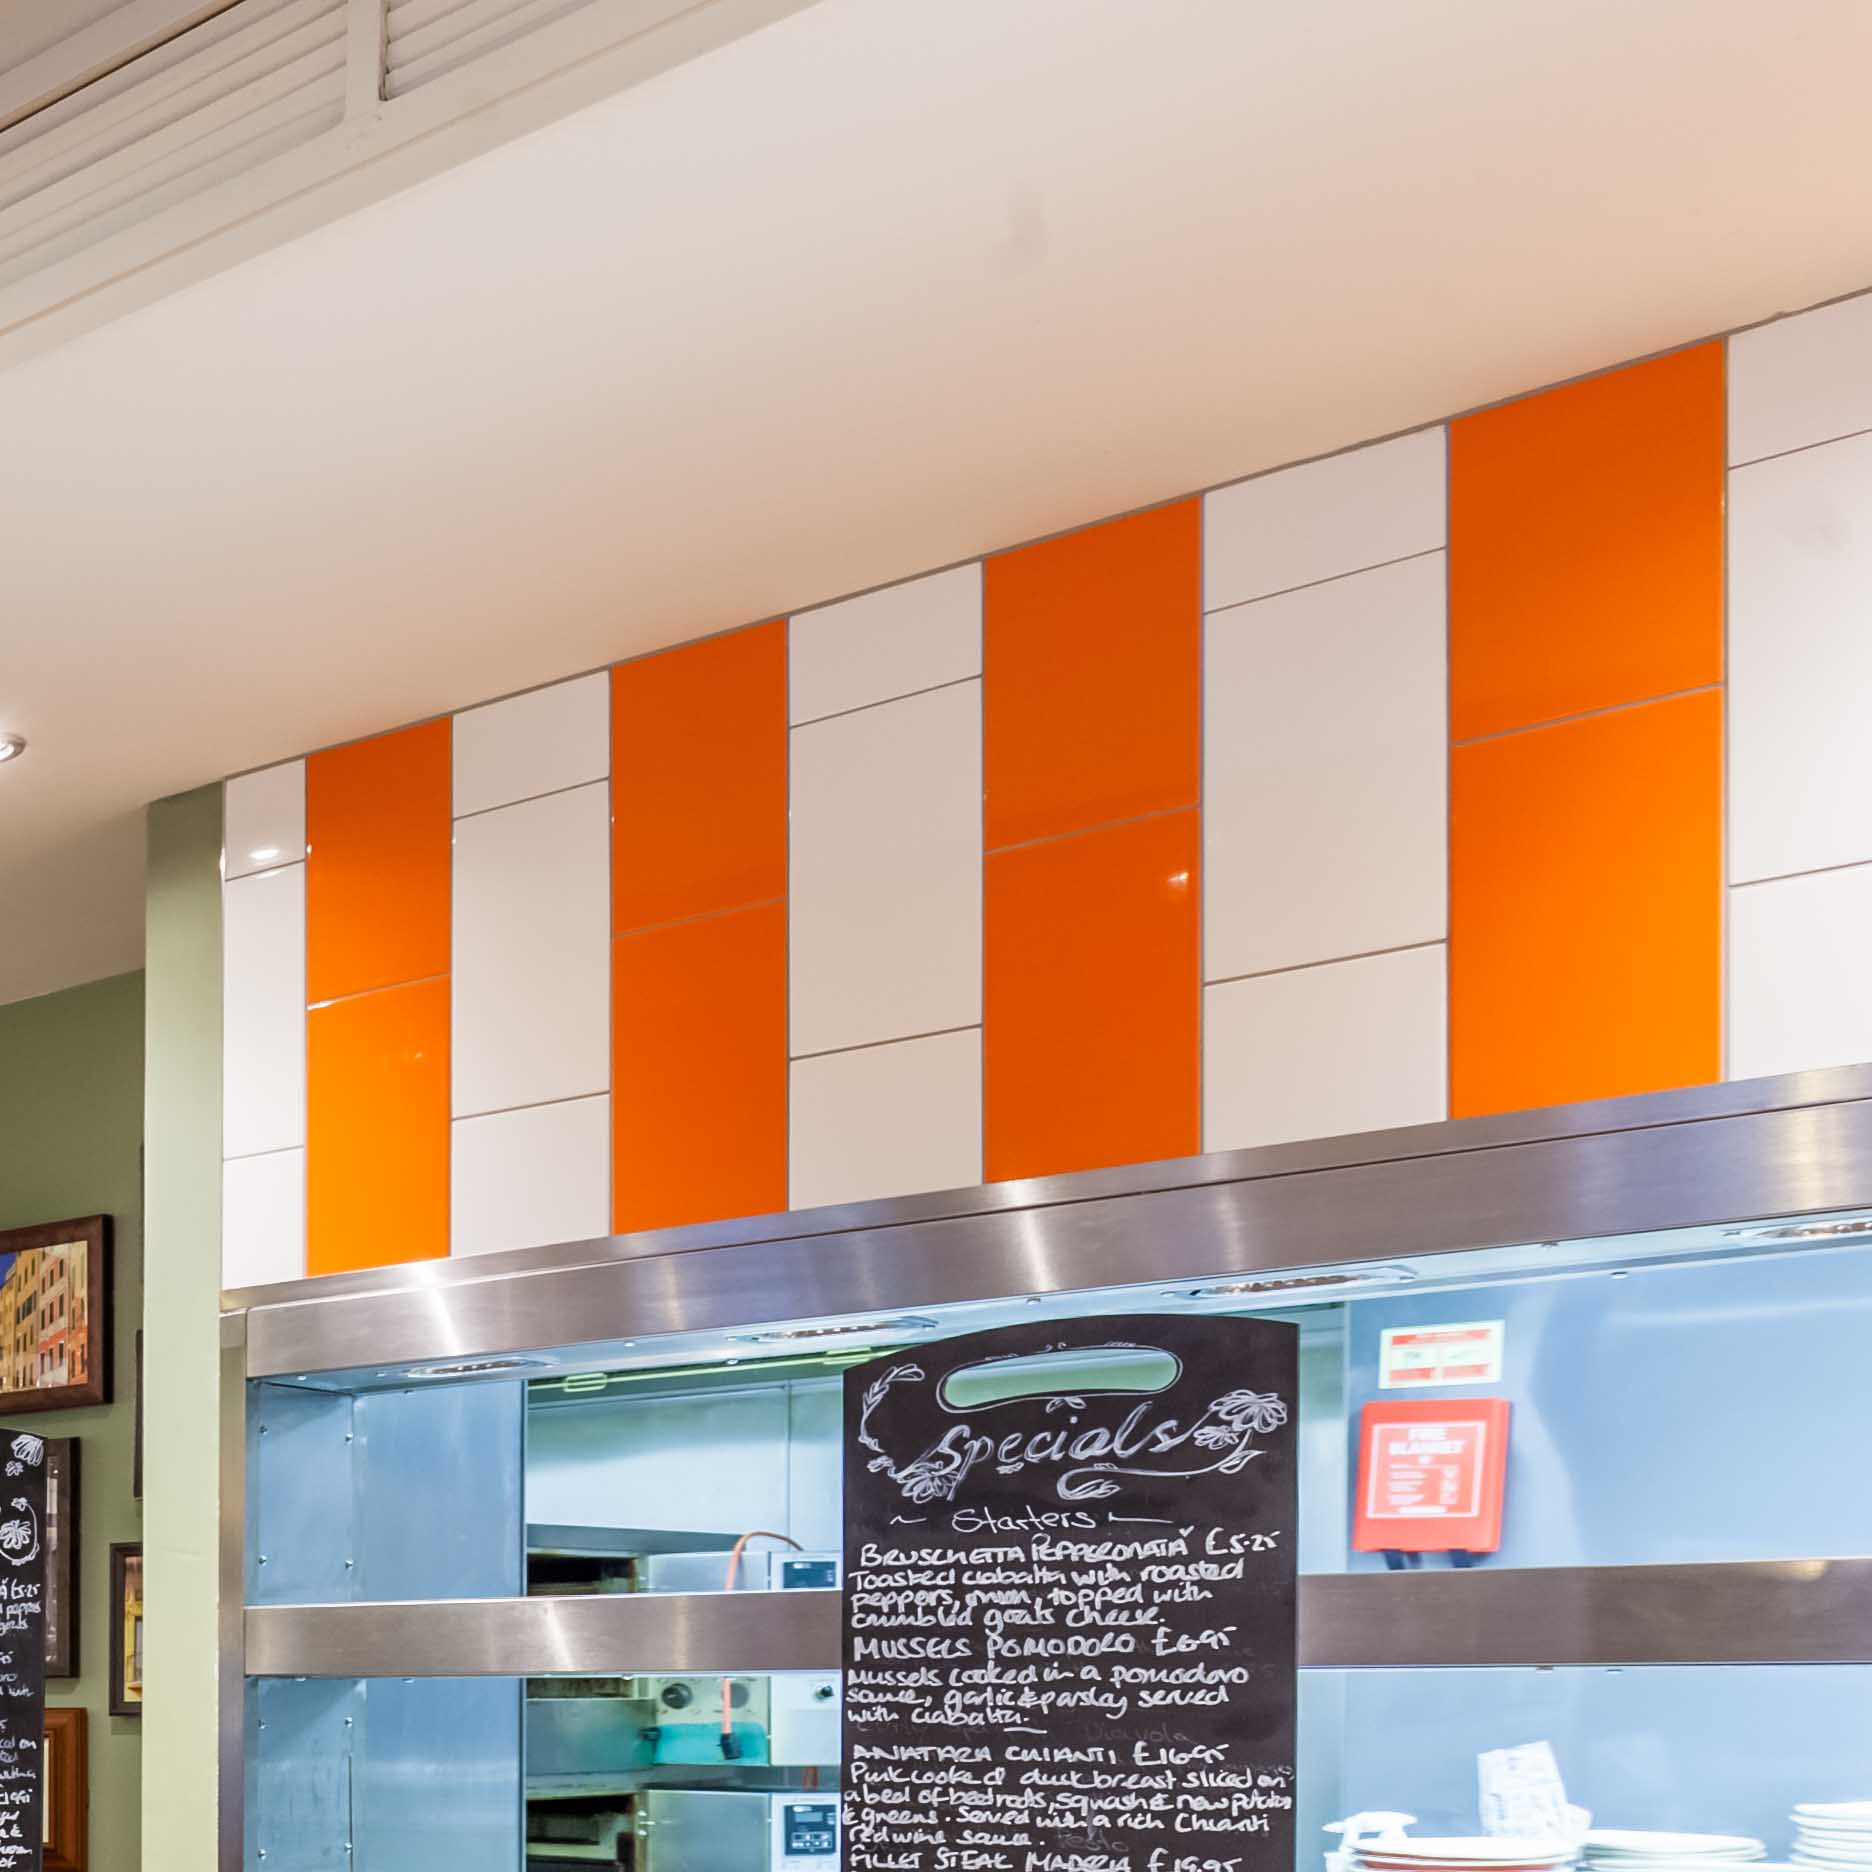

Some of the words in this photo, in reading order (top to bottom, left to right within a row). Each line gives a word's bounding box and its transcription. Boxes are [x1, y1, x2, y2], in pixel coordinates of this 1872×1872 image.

[908, 1402, 1181, 1499] Specials
[951, 1504, 1097, 1534] Starters
[847, 1567, 956, 1592] Toasted
[1070, 1562, 1131, 1586] with
[1139, 1556, 1246, 1583] roasted
[1047, 1582, 1145, 1611] topped
[1153, 1580, 1214, 1603] with
[853, 1635, 973, 1662] MUSSELS
[846, 1665, 944, 1687] Mussels
[948, 1659, 1039, 1687] cooked
[1080, 1664, 1103, 1681] a
[1137, 1684, 1230, 1708] served
[847, 1704, 900, 1723] with
[1092, 1813, 1112, 1828] a
[934, 1846, 1014, 1870] STEAK
